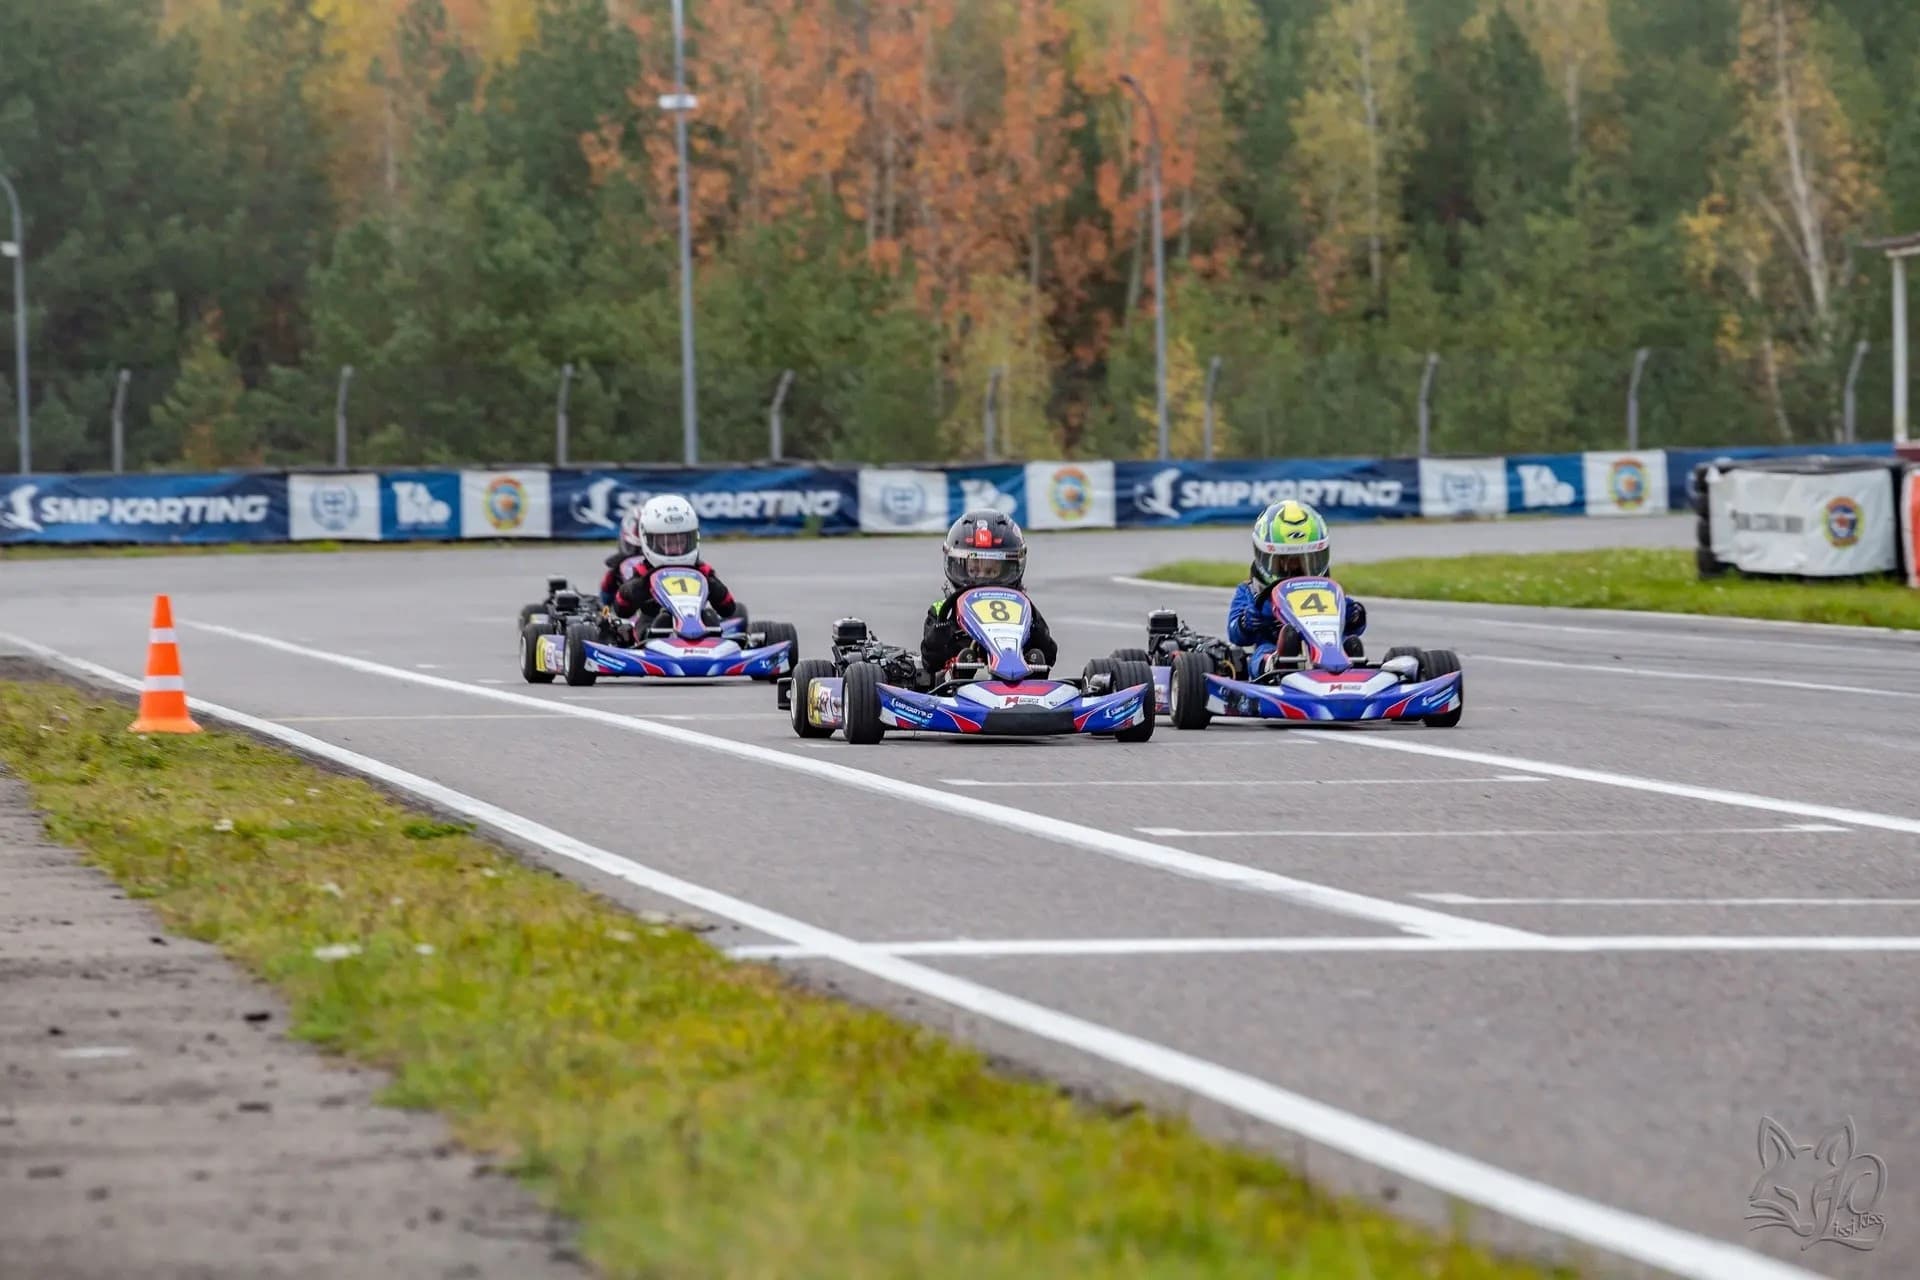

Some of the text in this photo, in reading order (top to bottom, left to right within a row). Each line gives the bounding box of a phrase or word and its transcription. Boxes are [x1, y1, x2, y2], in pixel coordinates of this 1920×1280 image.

[672, 579, 688, 593] 1
[989, 600, 1010, 621] 8
[1300, 592, 1328, 612] 4
